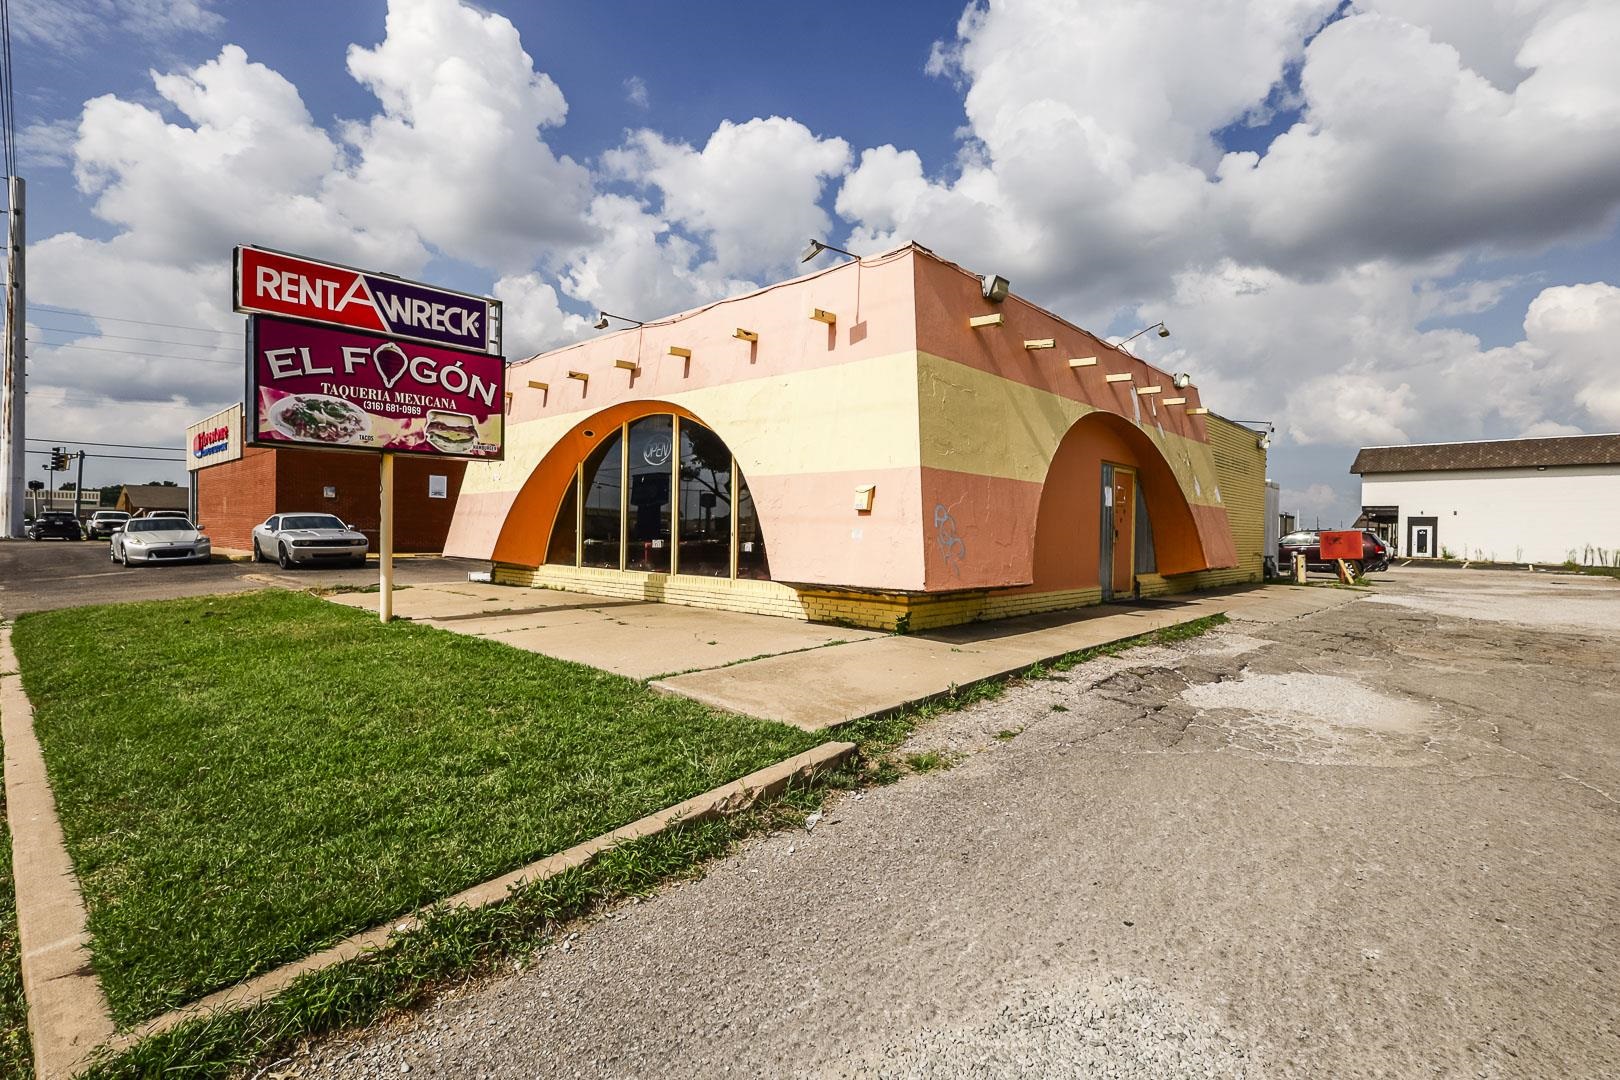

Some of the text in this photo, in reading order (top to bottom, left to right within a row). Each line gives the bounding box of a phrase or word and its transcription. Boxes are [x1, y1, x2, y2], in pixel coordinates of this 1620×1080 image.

[256, 265, 481, 338] RENT A WRECK
[263, 341, 498, 408] EL FOGÓN
[320, 382, 457, 410] TAQUERIA MEXICANA
[363, 400, 422, 415] (316) 681-0969
